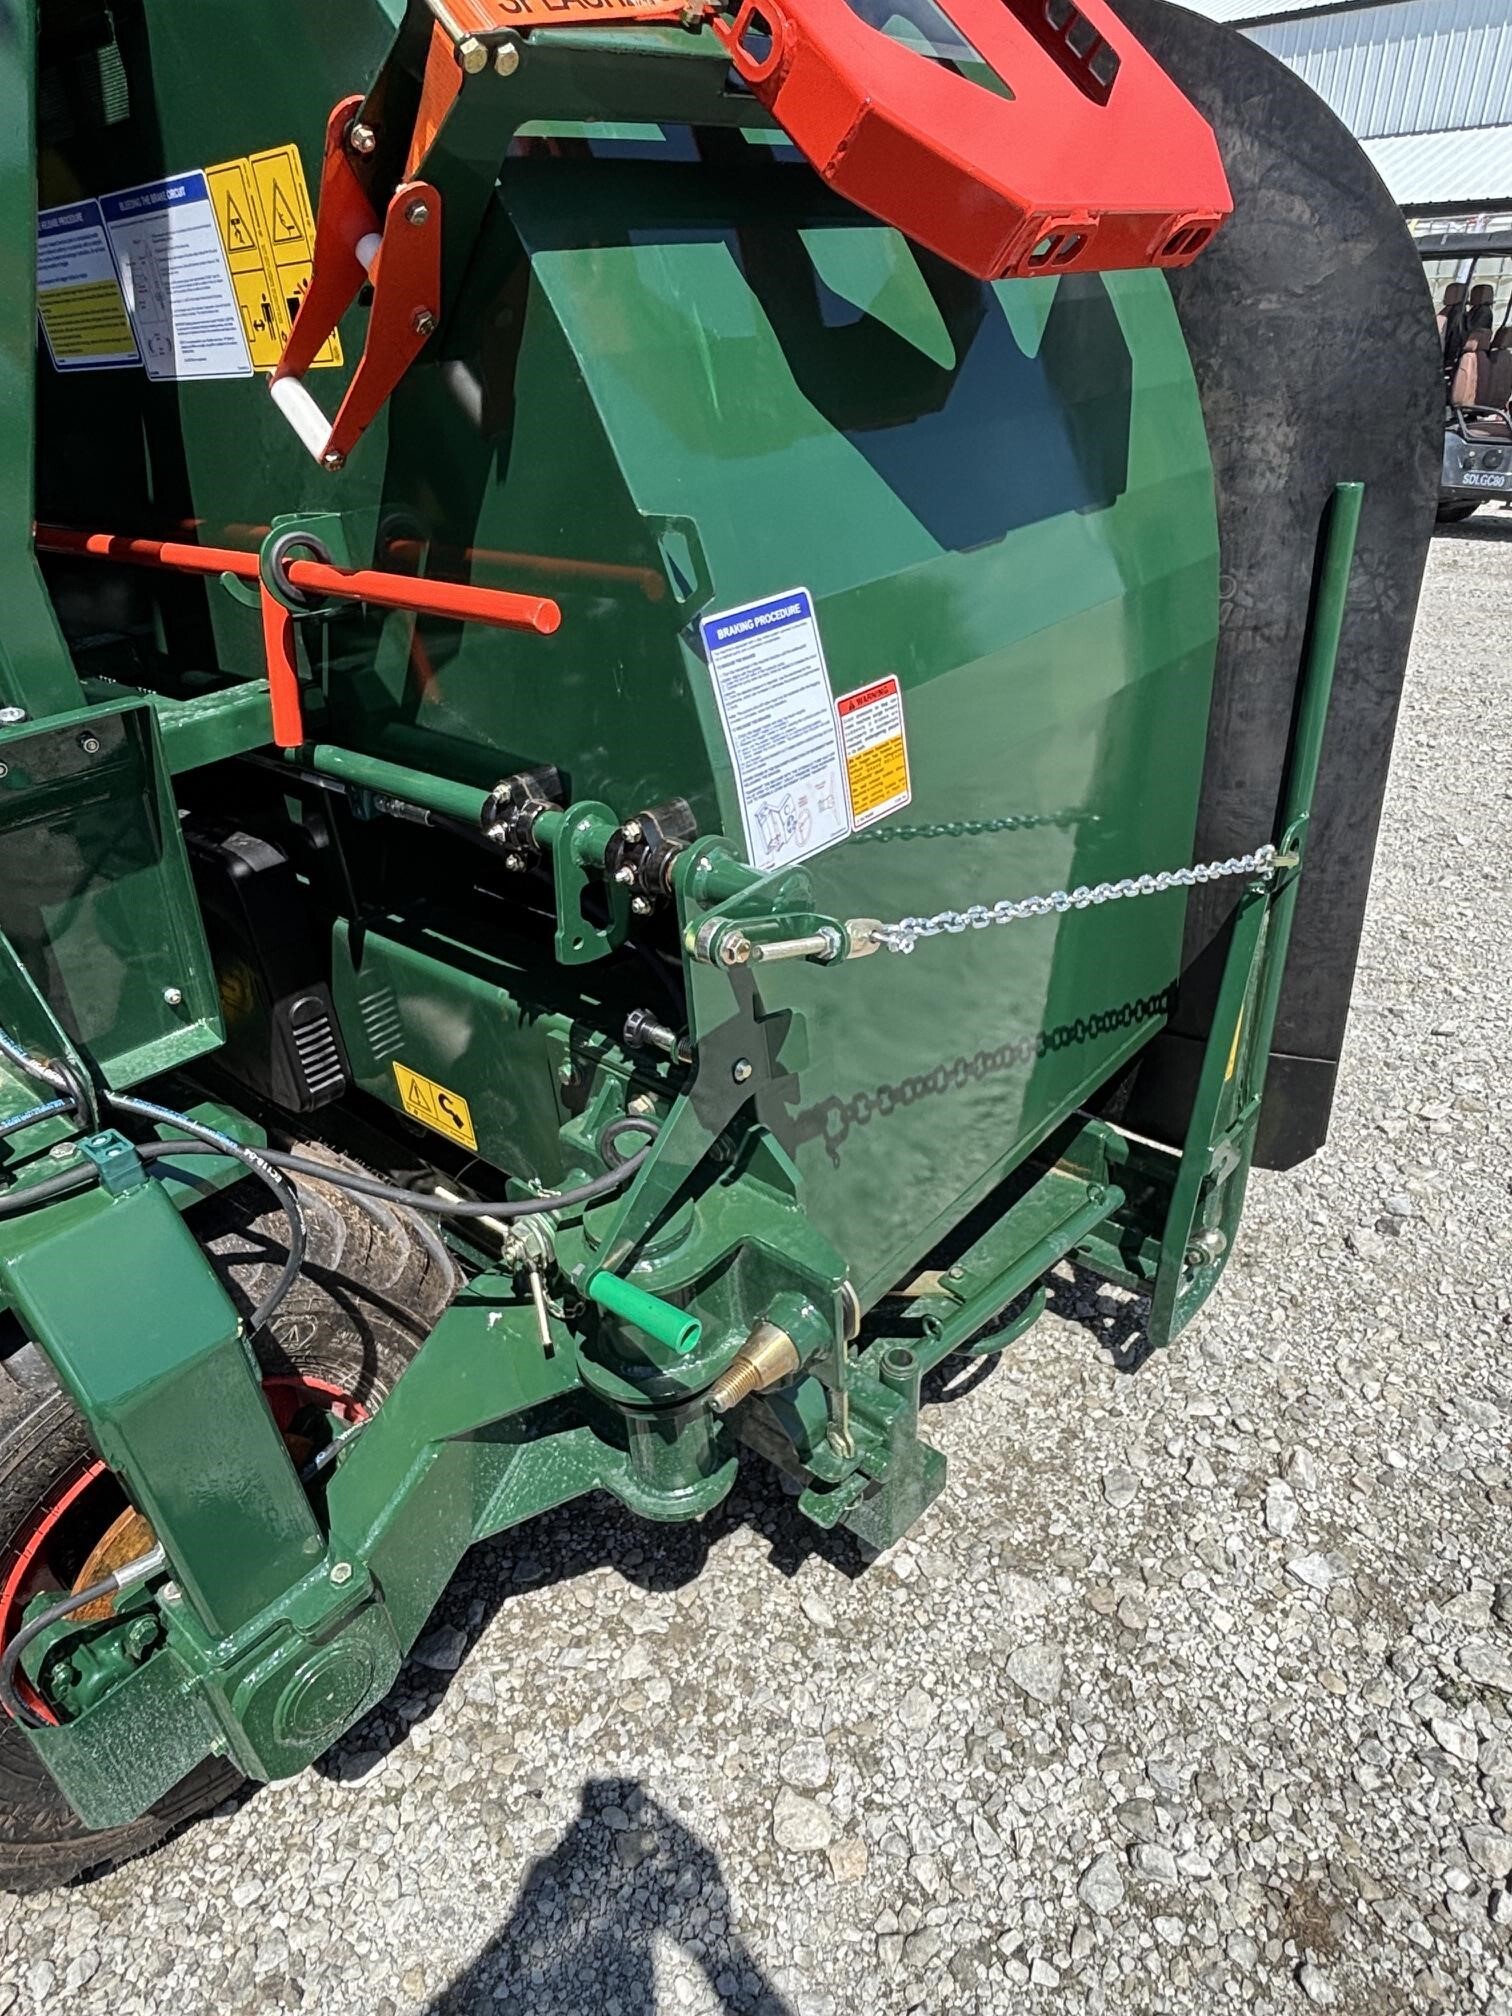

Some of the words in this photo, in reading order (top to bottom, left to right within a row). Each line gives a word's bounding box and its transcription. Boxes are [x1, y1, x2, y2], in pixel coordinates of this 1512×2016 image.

[717, 619, 754, 640] BRAKING
[754, 603, 801, 628] PROCEDURE
[857, 686, 889, 705] WARNING
